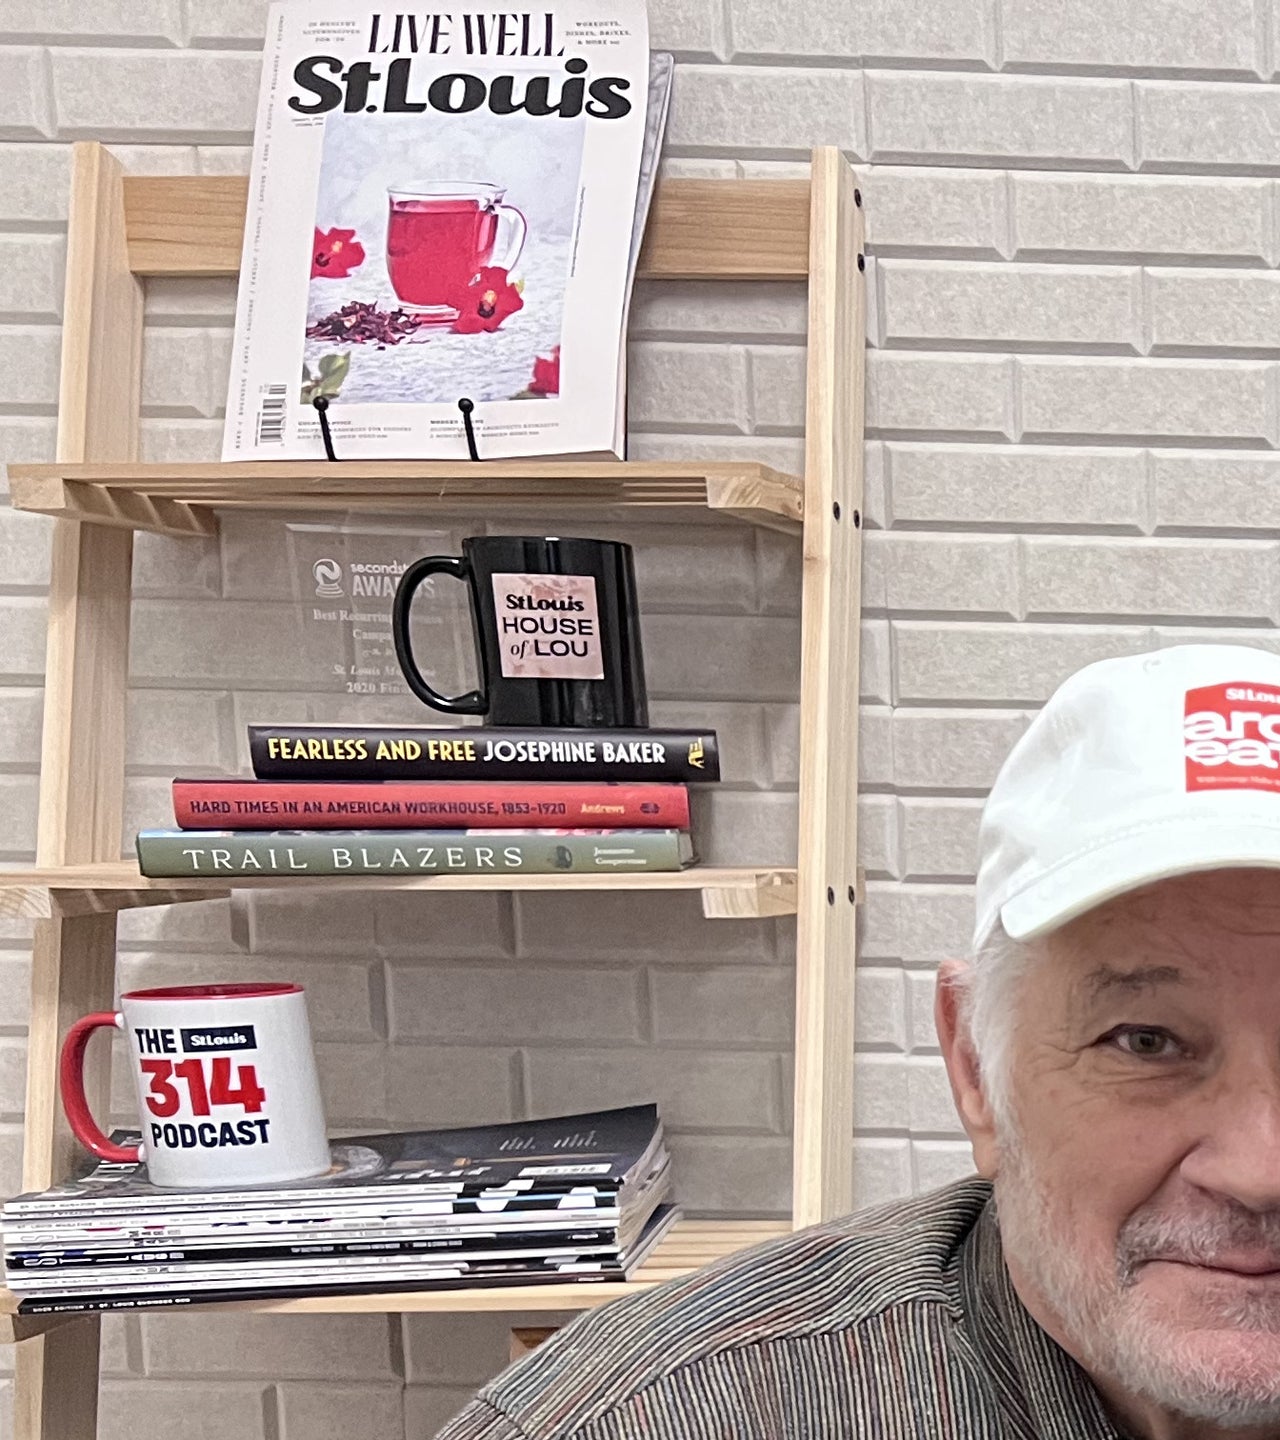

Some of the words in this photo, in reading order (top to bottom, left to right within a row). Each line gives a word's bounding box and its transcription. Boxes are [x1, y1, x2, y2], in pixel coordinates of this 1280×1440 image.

[368, 14, 453, 54] LIVE
[463, 13, 565, 57] WELL
[351, 560, 410, 574] secondst
[352, 575, 436, 598] AWAS
[353, 629, 393, 641] Campa
[502, 617, 593, 635] HOUSE
[510, 640, 529, 659] of
[534, 639, 588, 657] LOU
[267, 738, 368, 761] FEARLESS
[376, 739, 420, 760] AND
[429, 740, 476, 761] FREE
[483, 740, 597, 763] JOSEPHINE
[602, 742, 666, 764] BAKER
[190, 800, 230, 814] HARD
[236, 801, 278, 814] TIMES
[282, 801, 298, 813] IN
[303, 801, 323, 814] AN
[327, 801, 401, 814] AMERICAN
[405, 802, 499, 816] WORKHOUSE,
[183, 848, 308, 869] TRAIL
[332, 847, 523, 869] BLAZERS
[135, 1028, 177, 1053] THE
[140, 1057, 266, 1118] 314
[151, 1119, 270, 1149] PODCAST
